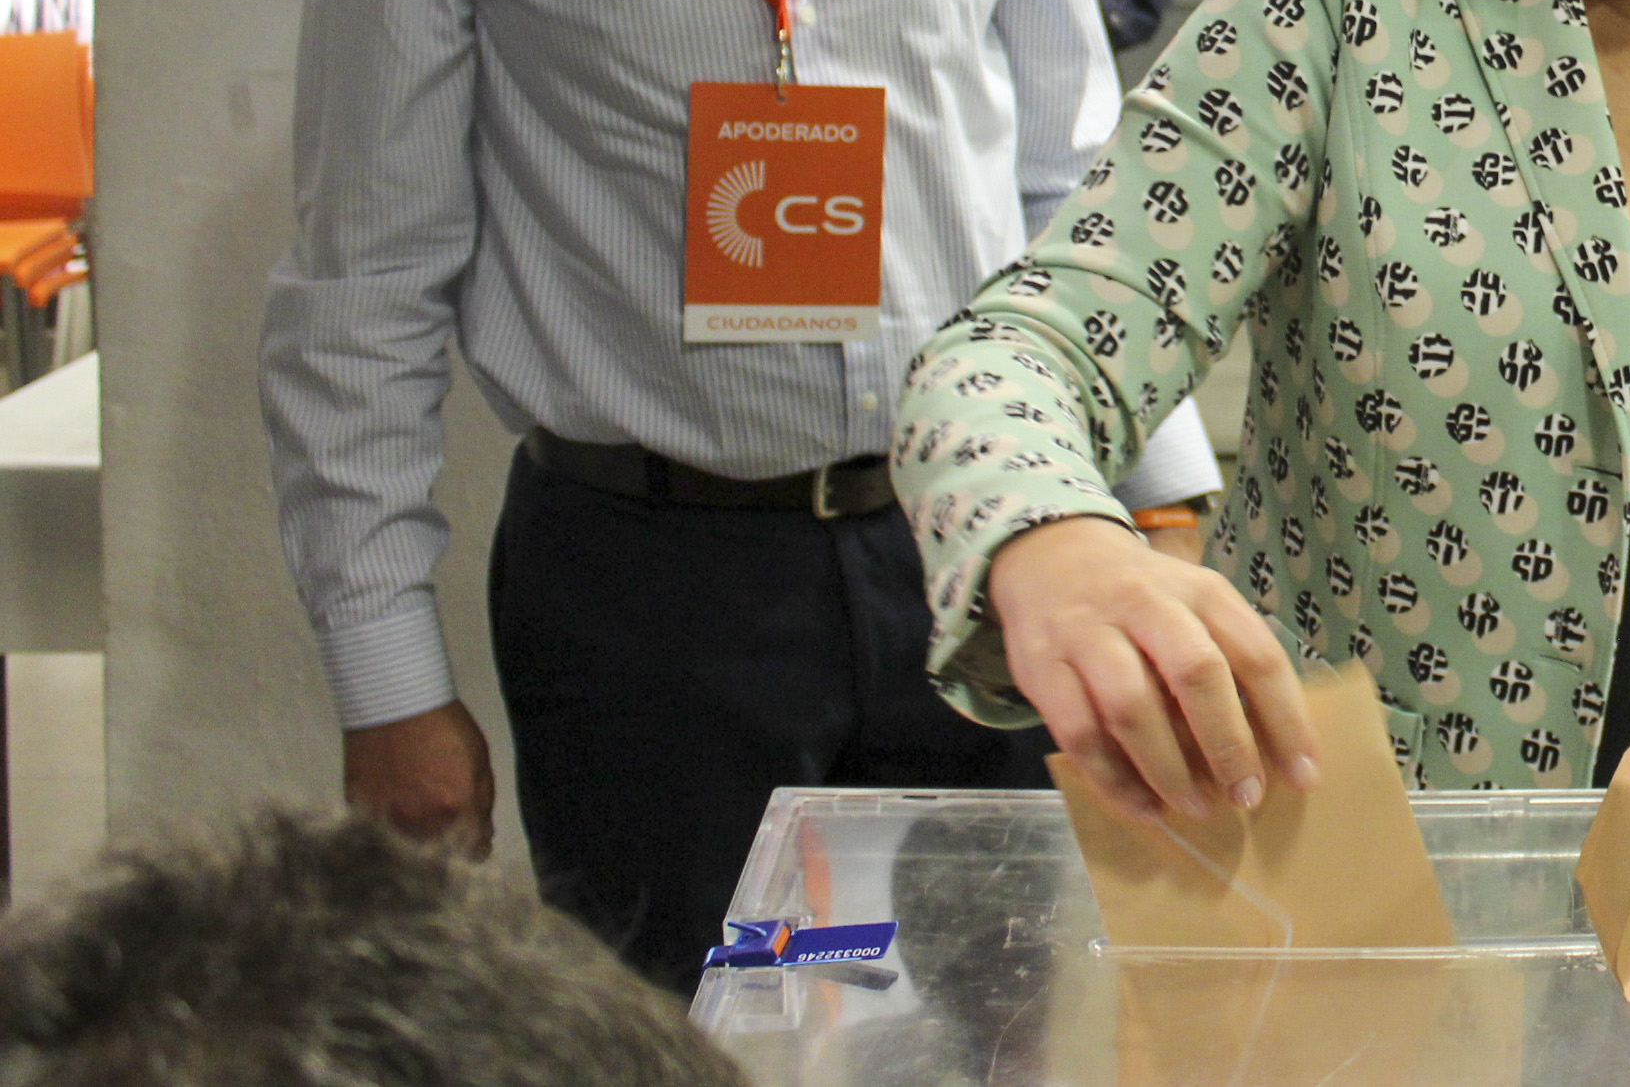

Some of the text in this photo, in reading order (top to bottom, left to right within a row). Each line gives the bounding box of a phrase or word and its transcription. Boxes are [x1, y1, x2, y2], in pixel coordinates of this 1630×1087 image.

[718, 121, 859, 143] APODERADO
[774, 195, 865, 236] CS
[706, 316, 858, 332] CIUDADANOS
[798, 947, 881, 961] 000332246
